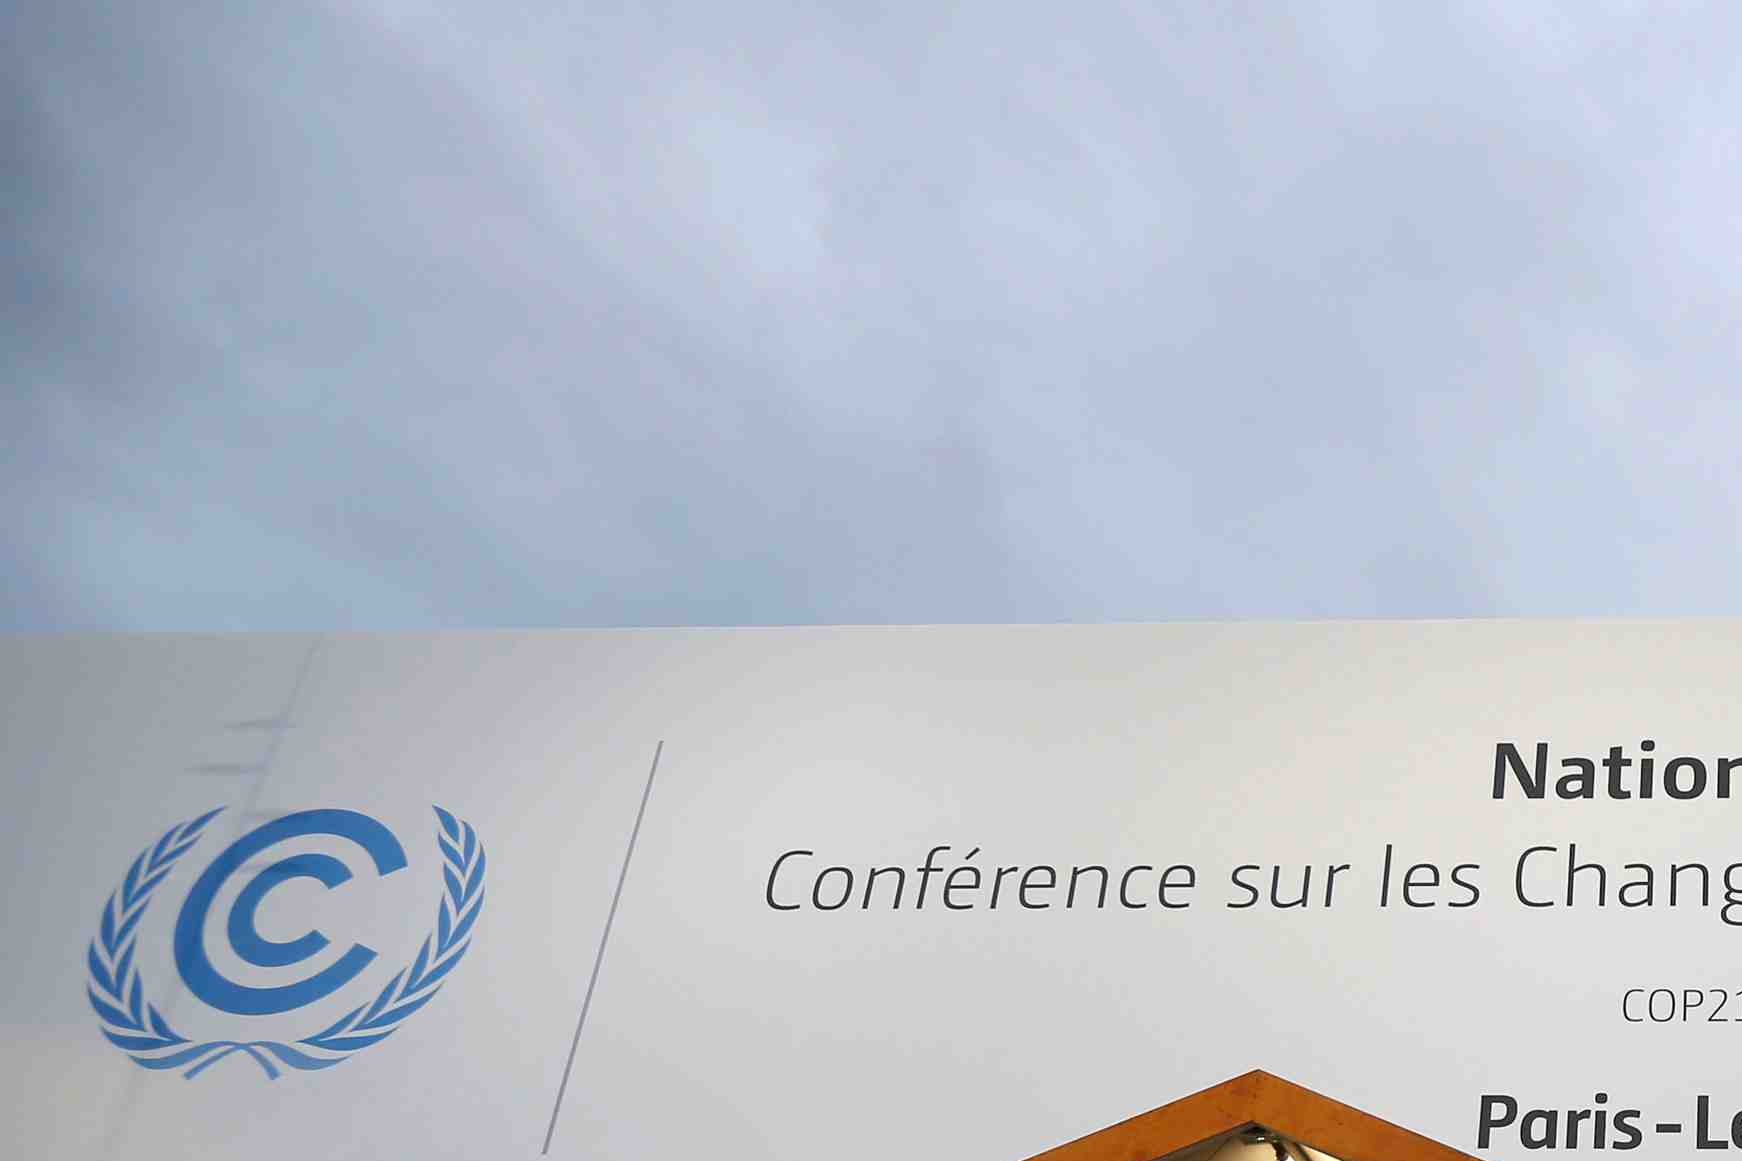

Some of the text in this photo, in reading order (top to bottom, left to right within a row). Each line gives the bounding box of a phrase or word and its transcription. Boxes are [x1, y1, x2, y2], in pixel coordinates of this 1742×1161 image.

[765, 845, 1197, 911] Conférence
[1226, 863, 1351, 909] sur
[1379, 843, 1481, 908] les
